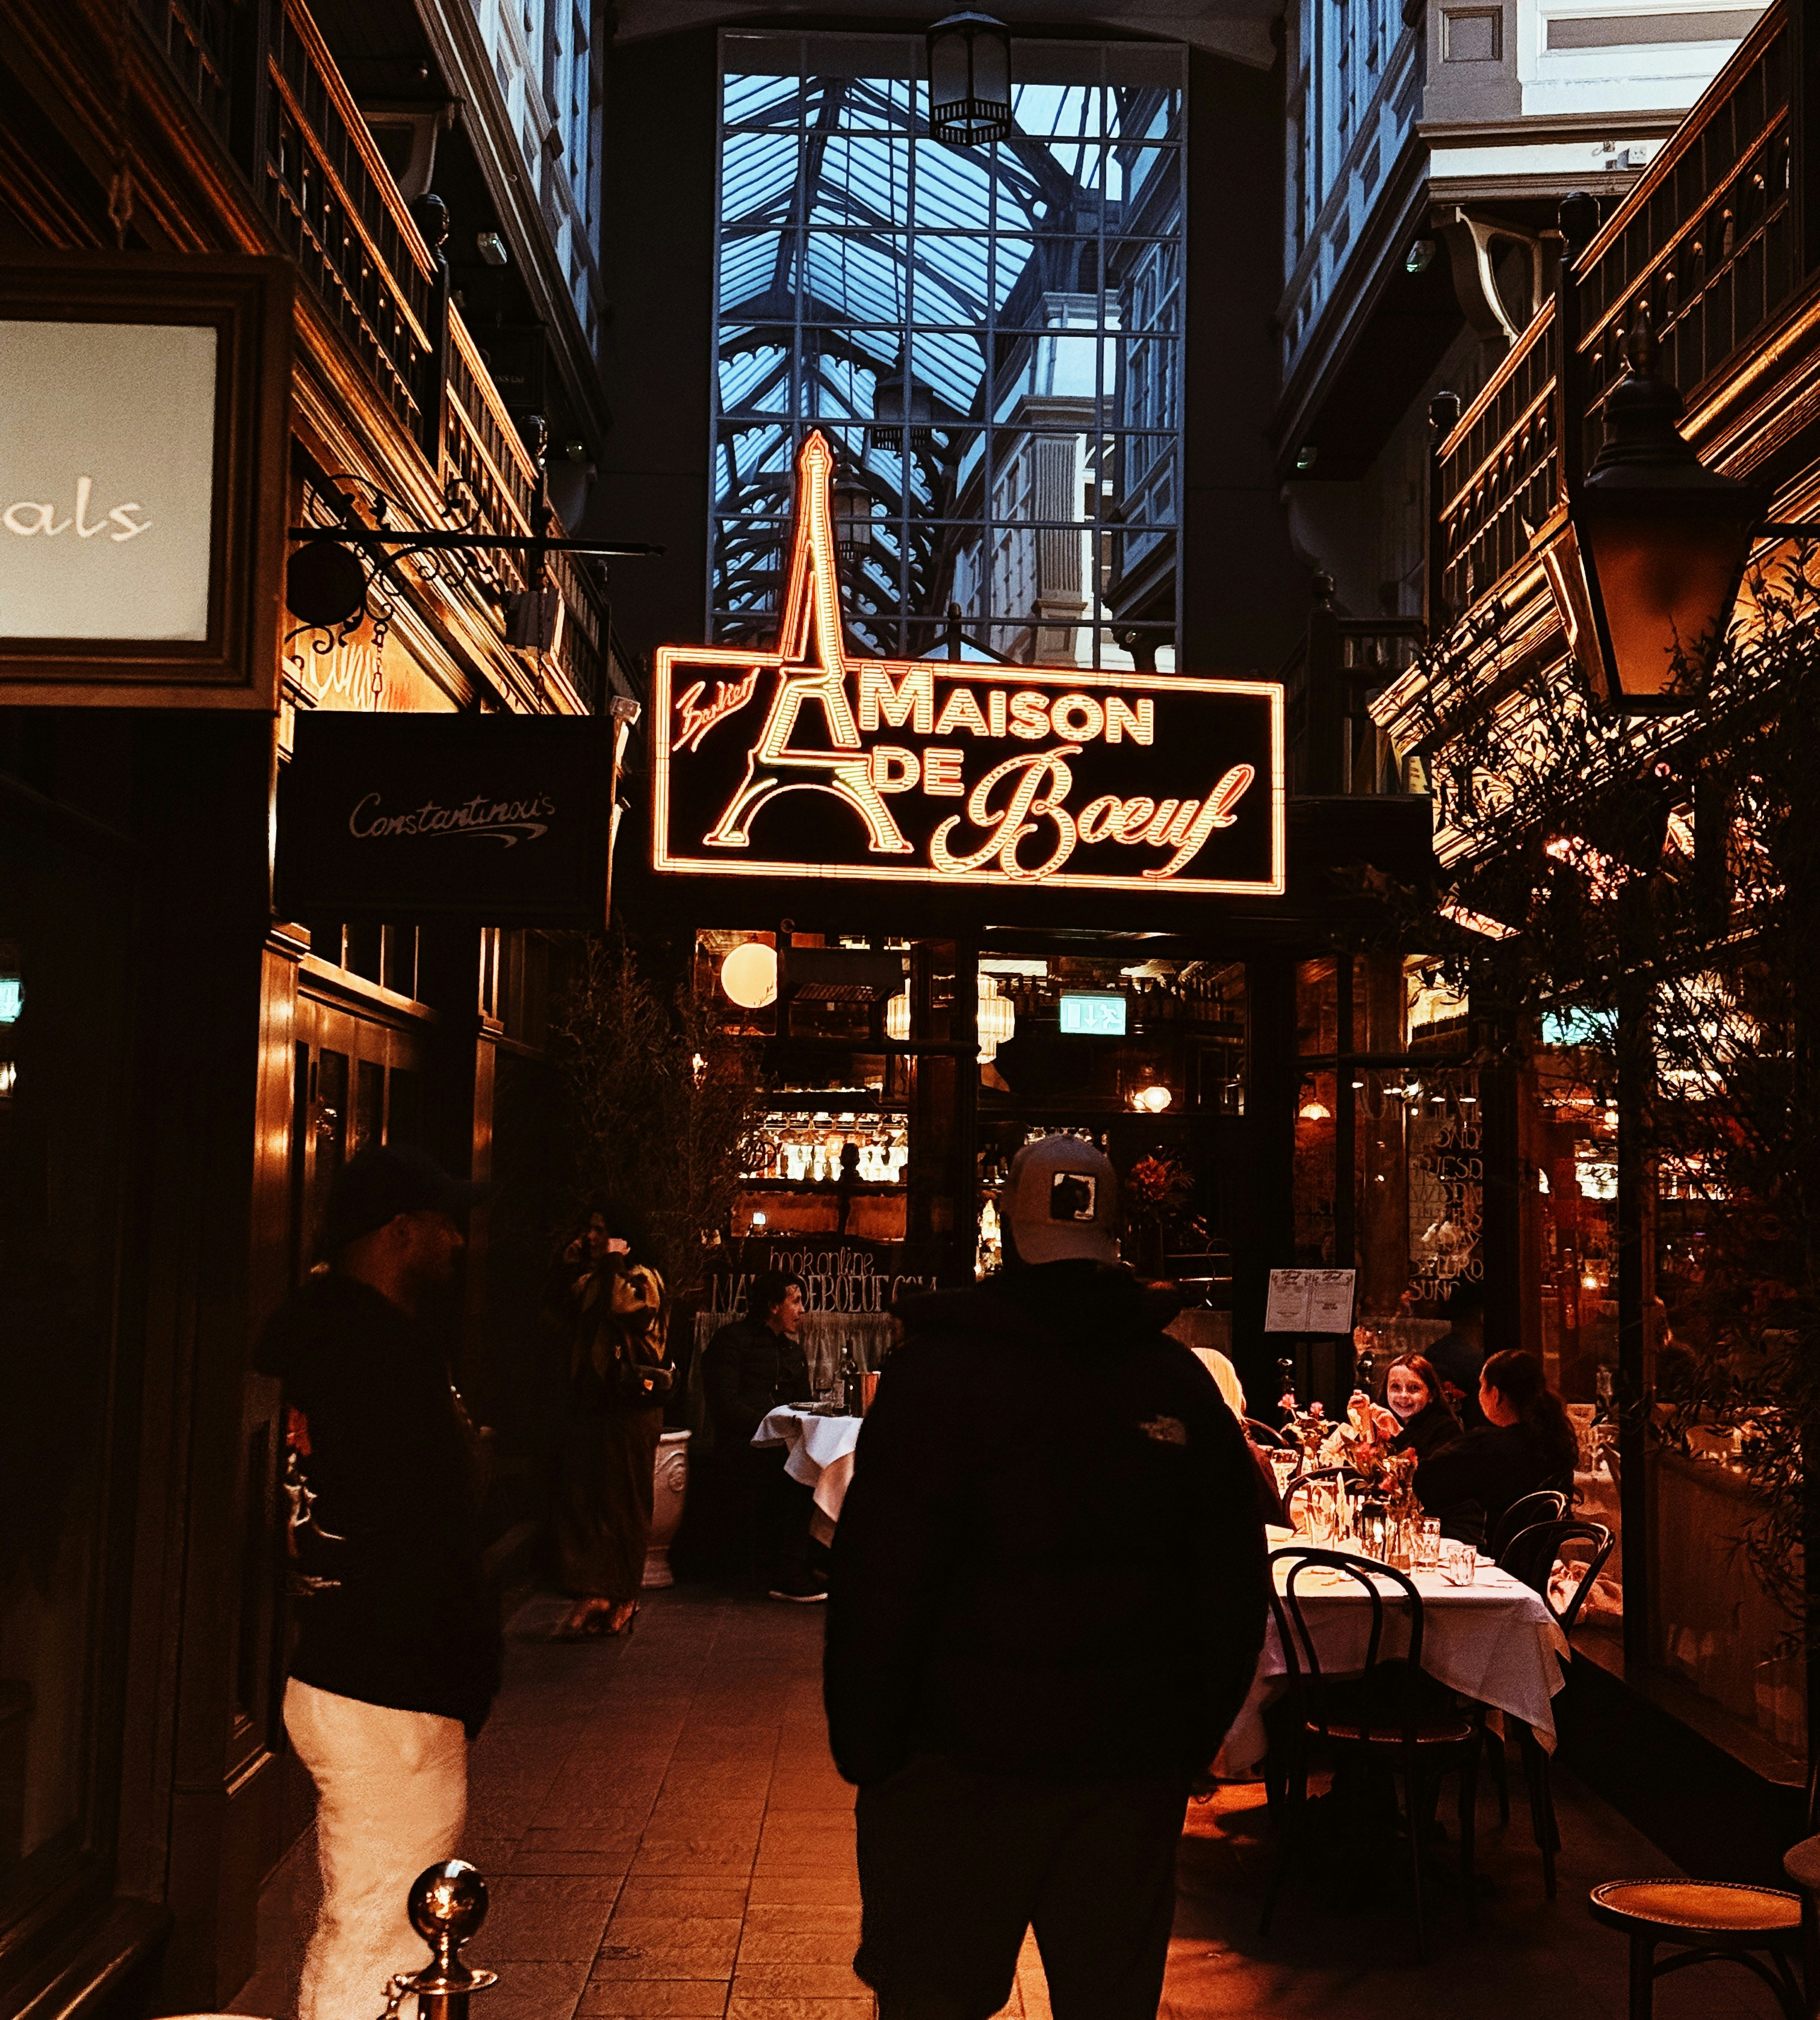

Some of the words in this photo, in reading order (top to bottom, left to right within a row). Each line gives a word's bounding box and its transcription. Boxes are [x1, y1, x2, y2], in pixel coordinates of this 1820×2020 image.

[873, 745, 965, 796] DE
[349, 792, 556, 838] Constantinou's
[769, 1246, 815, 1275] book
[817, 1246, 874, 1276] online
